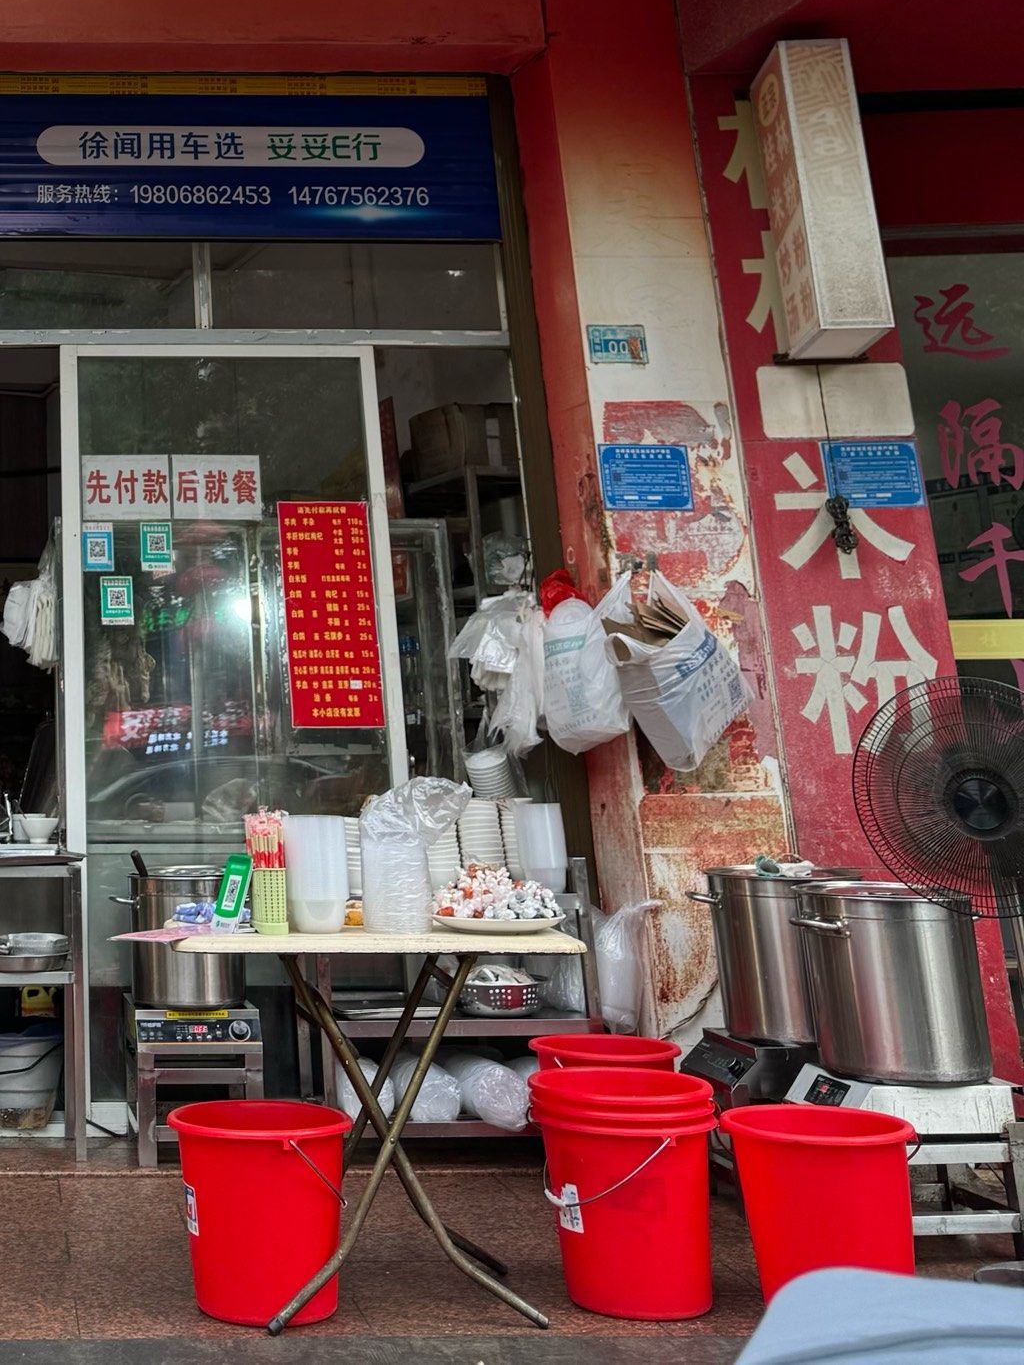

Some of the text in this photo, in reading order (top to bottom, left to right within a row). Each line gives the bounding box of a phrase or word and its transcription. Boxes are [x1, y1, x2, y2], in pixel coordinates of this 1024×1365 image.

[79, 131, 245, 160] 徐闻用车选
[130, 185, 271, 205] 19806862453
[288, 186, 429, 207] 14767562376
[86, 469, 258, 505] 先付款后就餐
